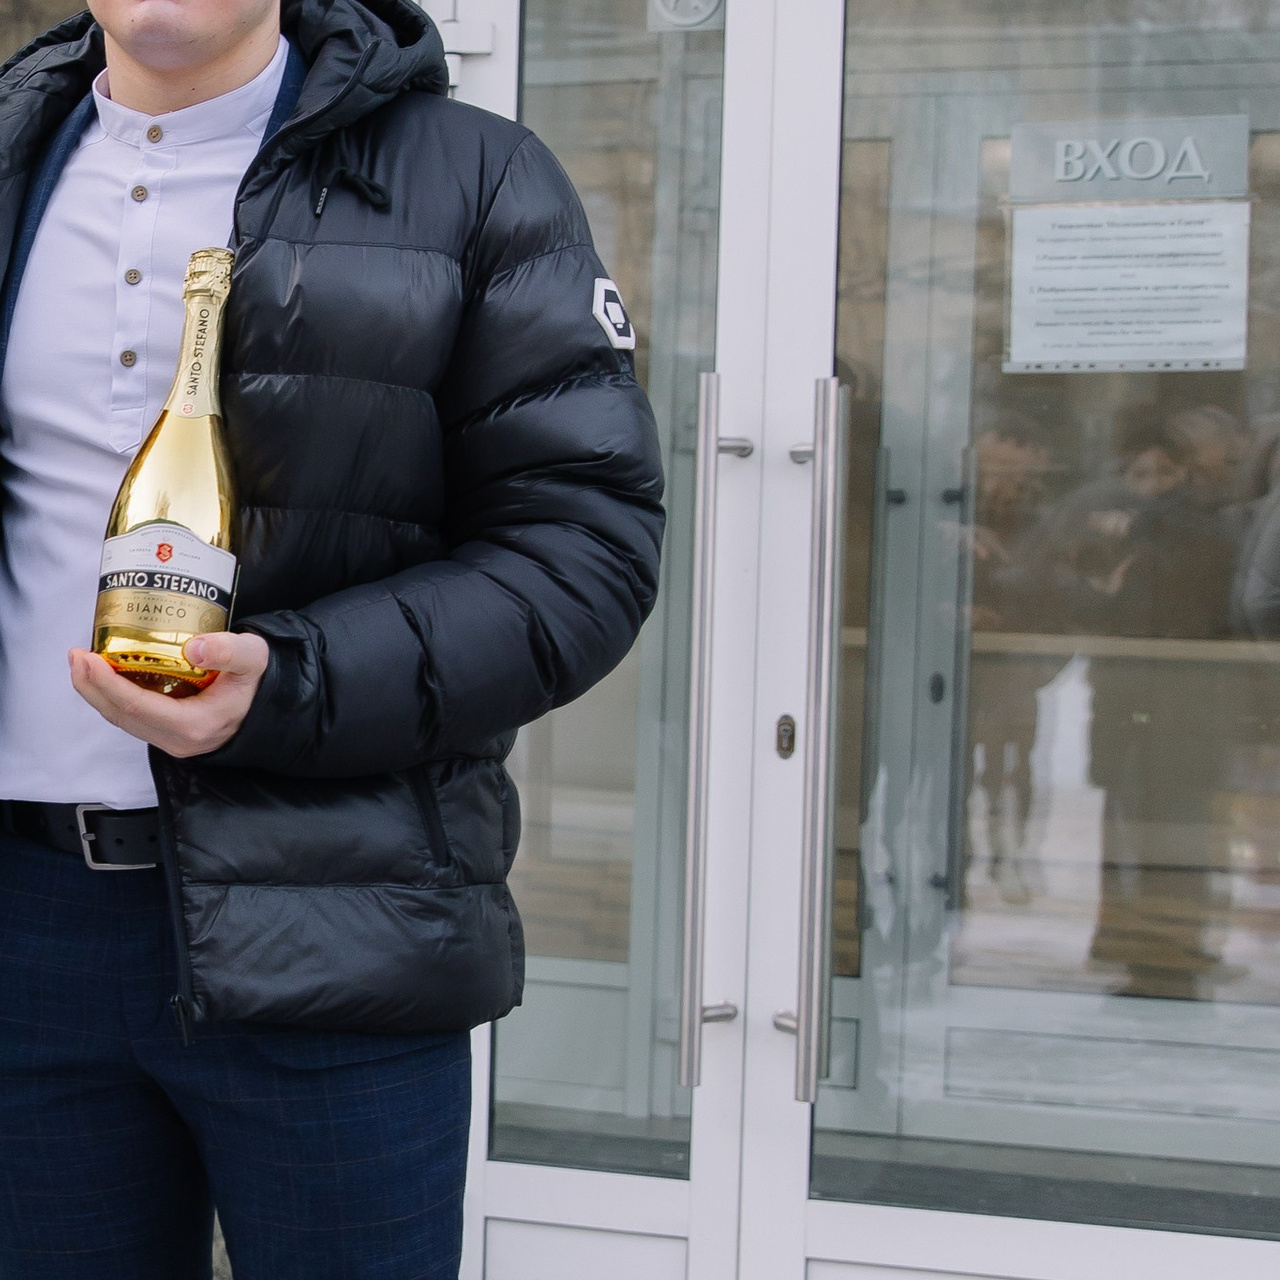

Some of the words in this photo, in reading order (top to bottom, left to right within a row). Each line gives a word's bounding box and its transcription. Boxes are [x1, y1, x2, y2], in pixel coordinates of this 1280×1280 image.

[1054, 135, 1212, 184] ВХОД
[193, 308, 210, 358] STEFANO
[186, 361, 202, 396] SANTO
[106, 572, 148, 588] SANTO
[153, 573, 219, 601] STEFANO
[126, 602, 187, 619] BIANCO
